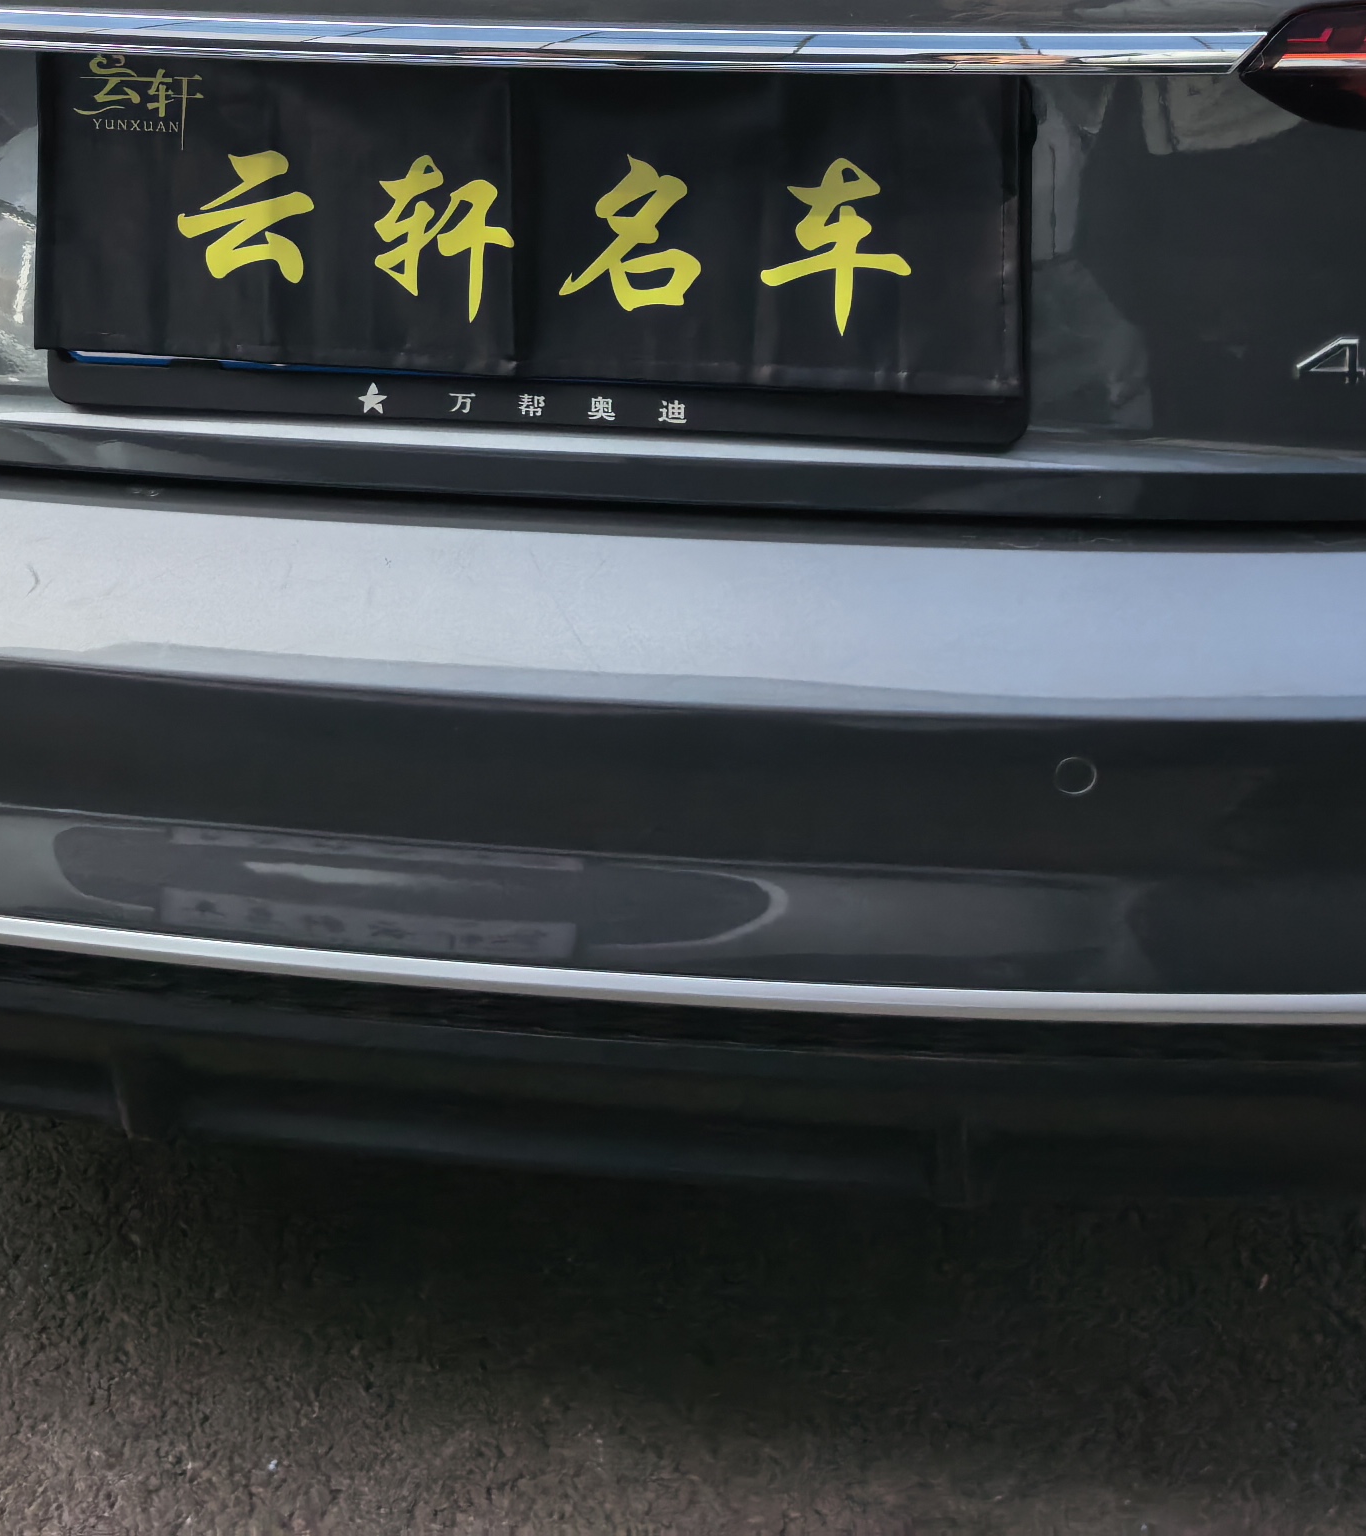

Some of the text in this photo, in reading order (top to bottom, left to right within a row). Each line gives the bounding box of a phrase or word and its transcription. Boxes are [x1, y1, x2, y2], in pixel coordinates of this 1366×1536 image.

[92, 117, 180, 133] YUNXUAN
[176, 149, 912, 336] 云轩名车
[448, 393, 688, 425] 万帮奥迪
